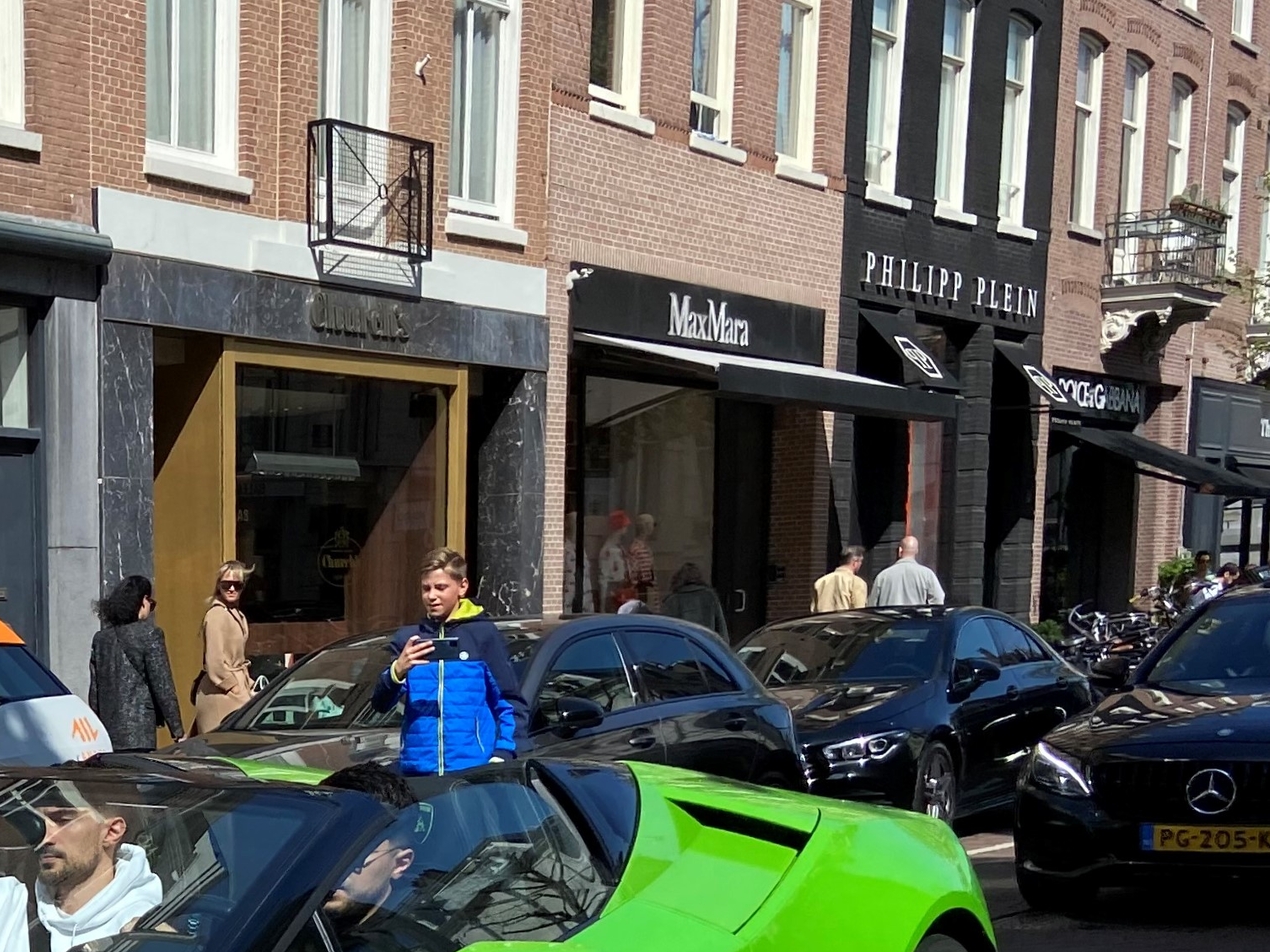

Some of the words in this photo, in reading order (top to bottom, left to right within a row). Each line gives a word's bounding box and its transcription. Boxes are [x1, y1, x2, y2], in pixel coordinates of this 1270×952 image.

[864, 250, 963, 302] PHILIPP
[975, 276, 1039, 319] PLEIN
[667, 291, 749, 347] MaxMara
